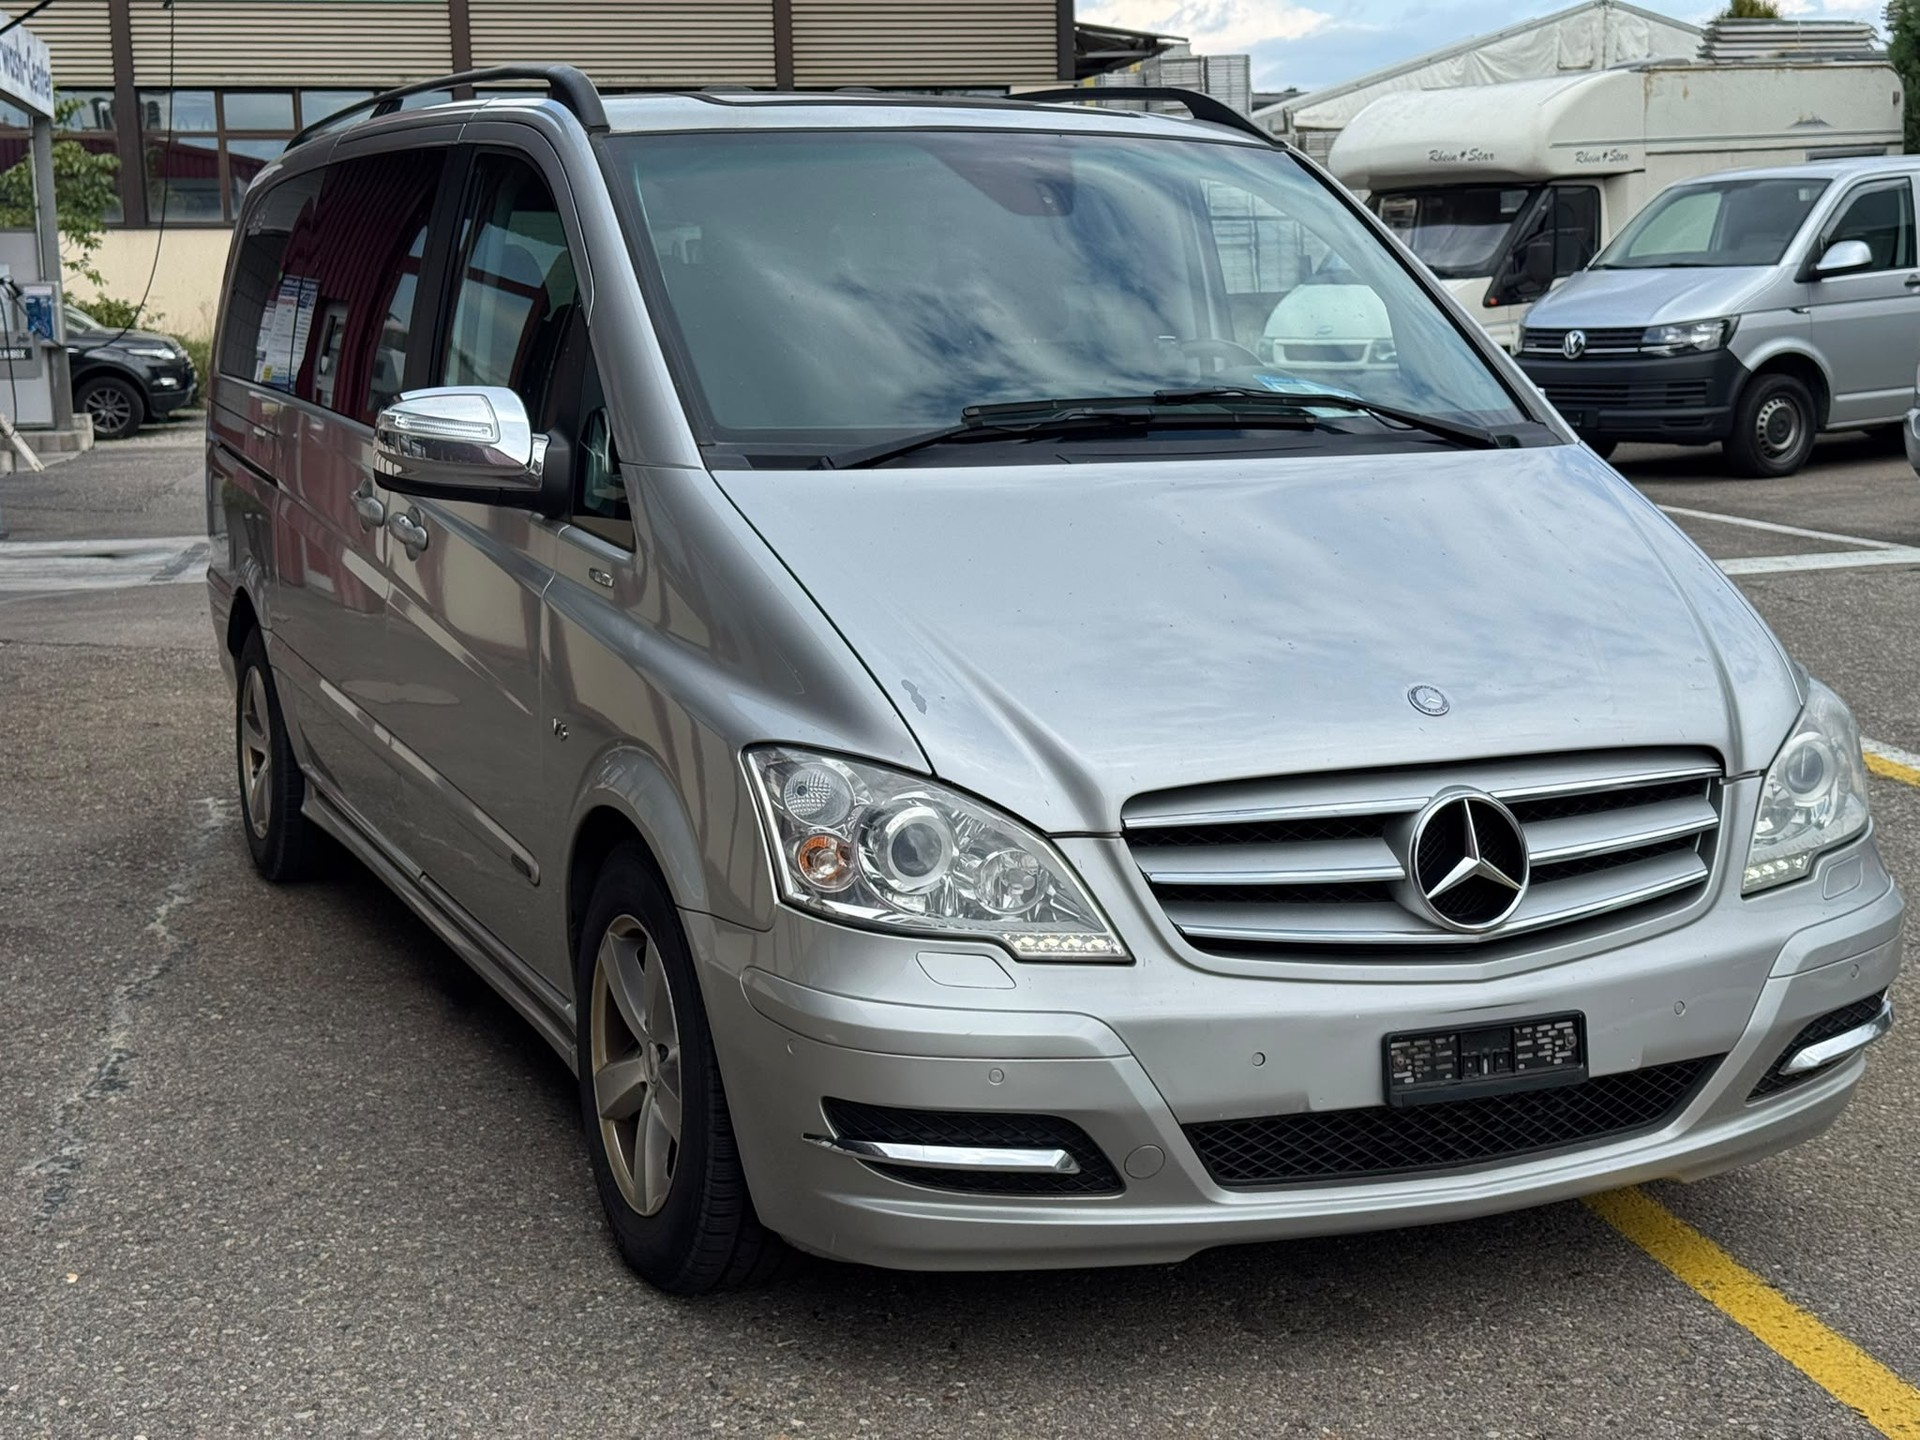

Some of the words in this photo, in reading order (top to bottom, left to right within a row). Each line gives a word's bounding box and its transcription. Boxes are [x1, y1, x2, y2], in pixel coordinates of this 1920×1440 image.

[1428, 149, 1458, 162] Rhein
[1467, 148, 1495, 162] Star
[1575, 150, 1601, 164] Rhein
[1608, 149, 1630, 163] Star
